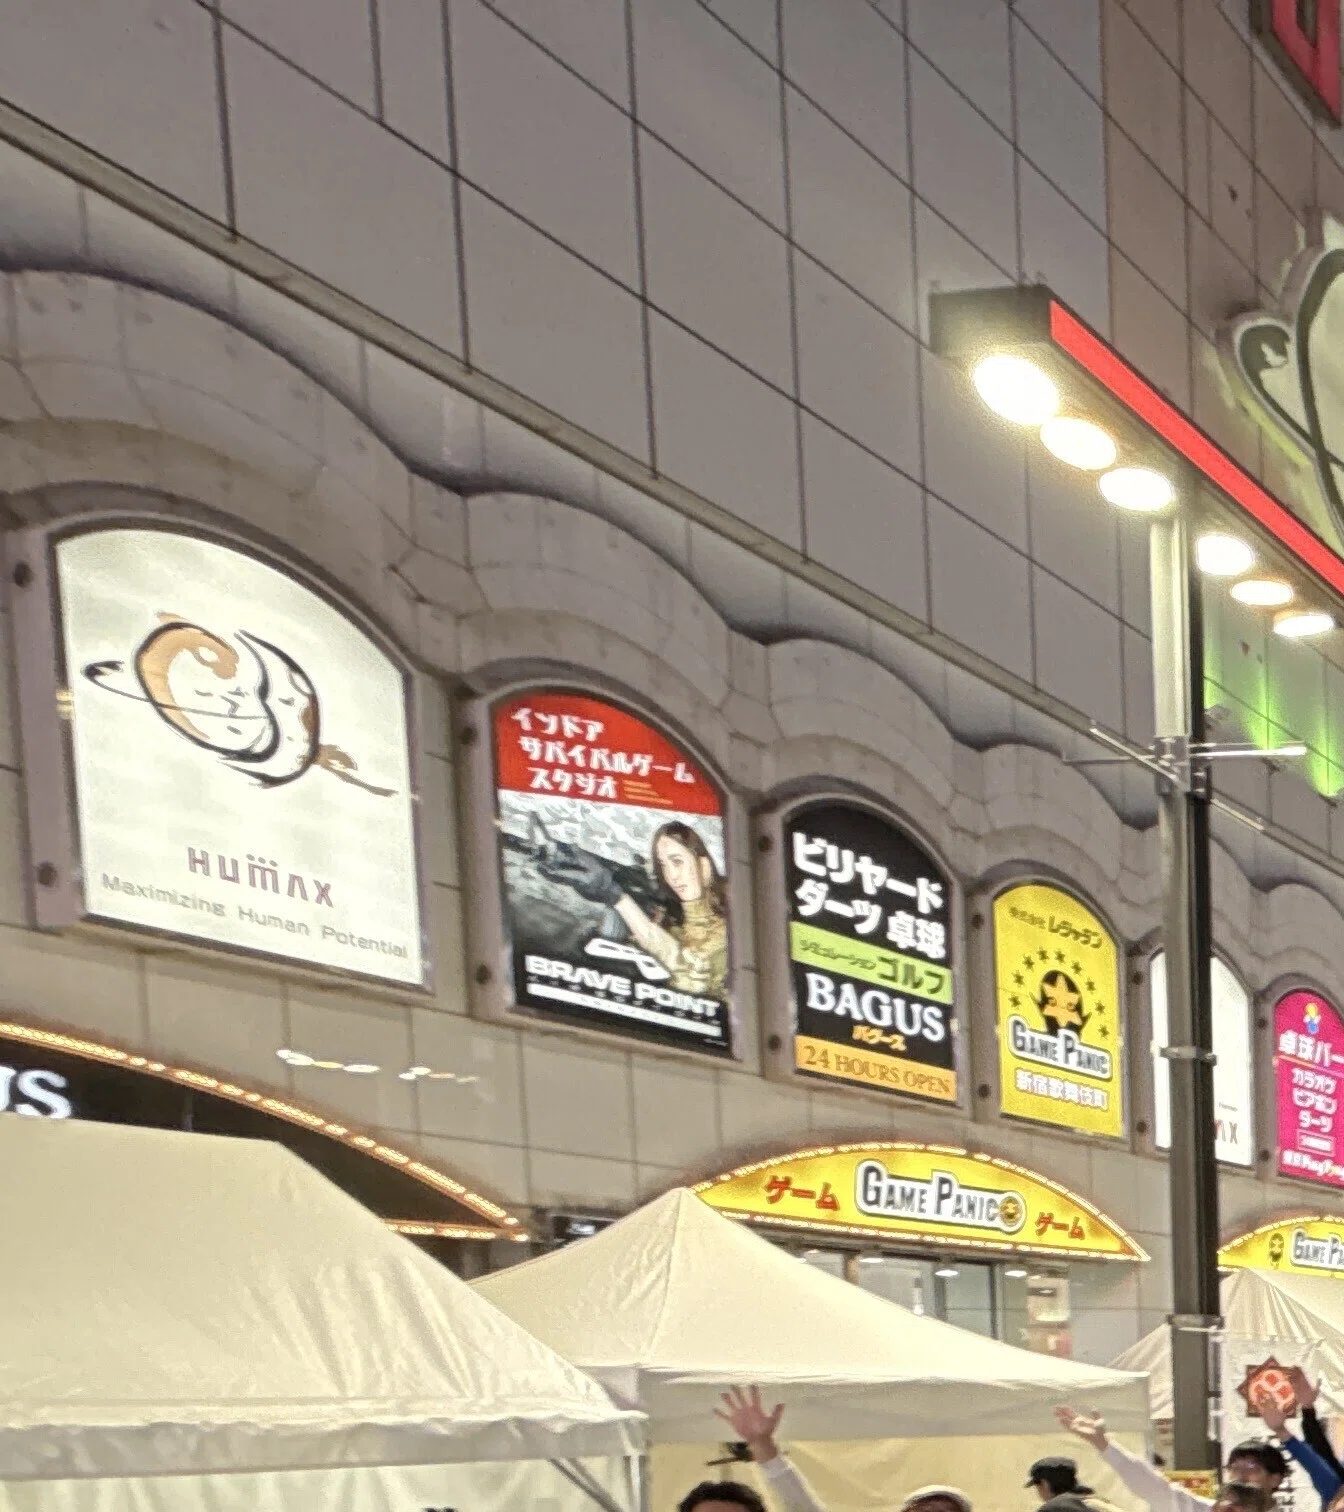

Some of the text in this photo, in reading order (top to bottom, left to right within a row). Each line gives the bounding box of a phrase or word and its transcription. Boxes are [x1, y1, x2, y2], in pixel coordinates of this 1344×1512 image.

[511, 707, 604, 741] インドア
[519, 736, 695, 783] サバイバルゲーム
[528, 766, 617, 799] スタジオ
[791, 831, 944, 914] ビリヤード
[102, 873, 408, 958] Maximizing Human Potential
[794, 878, 947, 960] ダーツ 卓球
[525, 954, 720, 1018] BRAVE POINT
[876, 952, 947, 996] ゴルフ
[805, 971, 945, 1043] BAGUS
[803, 1044, 951, 1096] 24 HOURS OPEN
[1011, 1018, 1109, 1076] GAME PANIC
[763, 1174, 841, 1212] ゲーム
[860, 1164, 999, 1224] GAME PANIC
[1034, 1212, 1087, 1240] ゲーム
